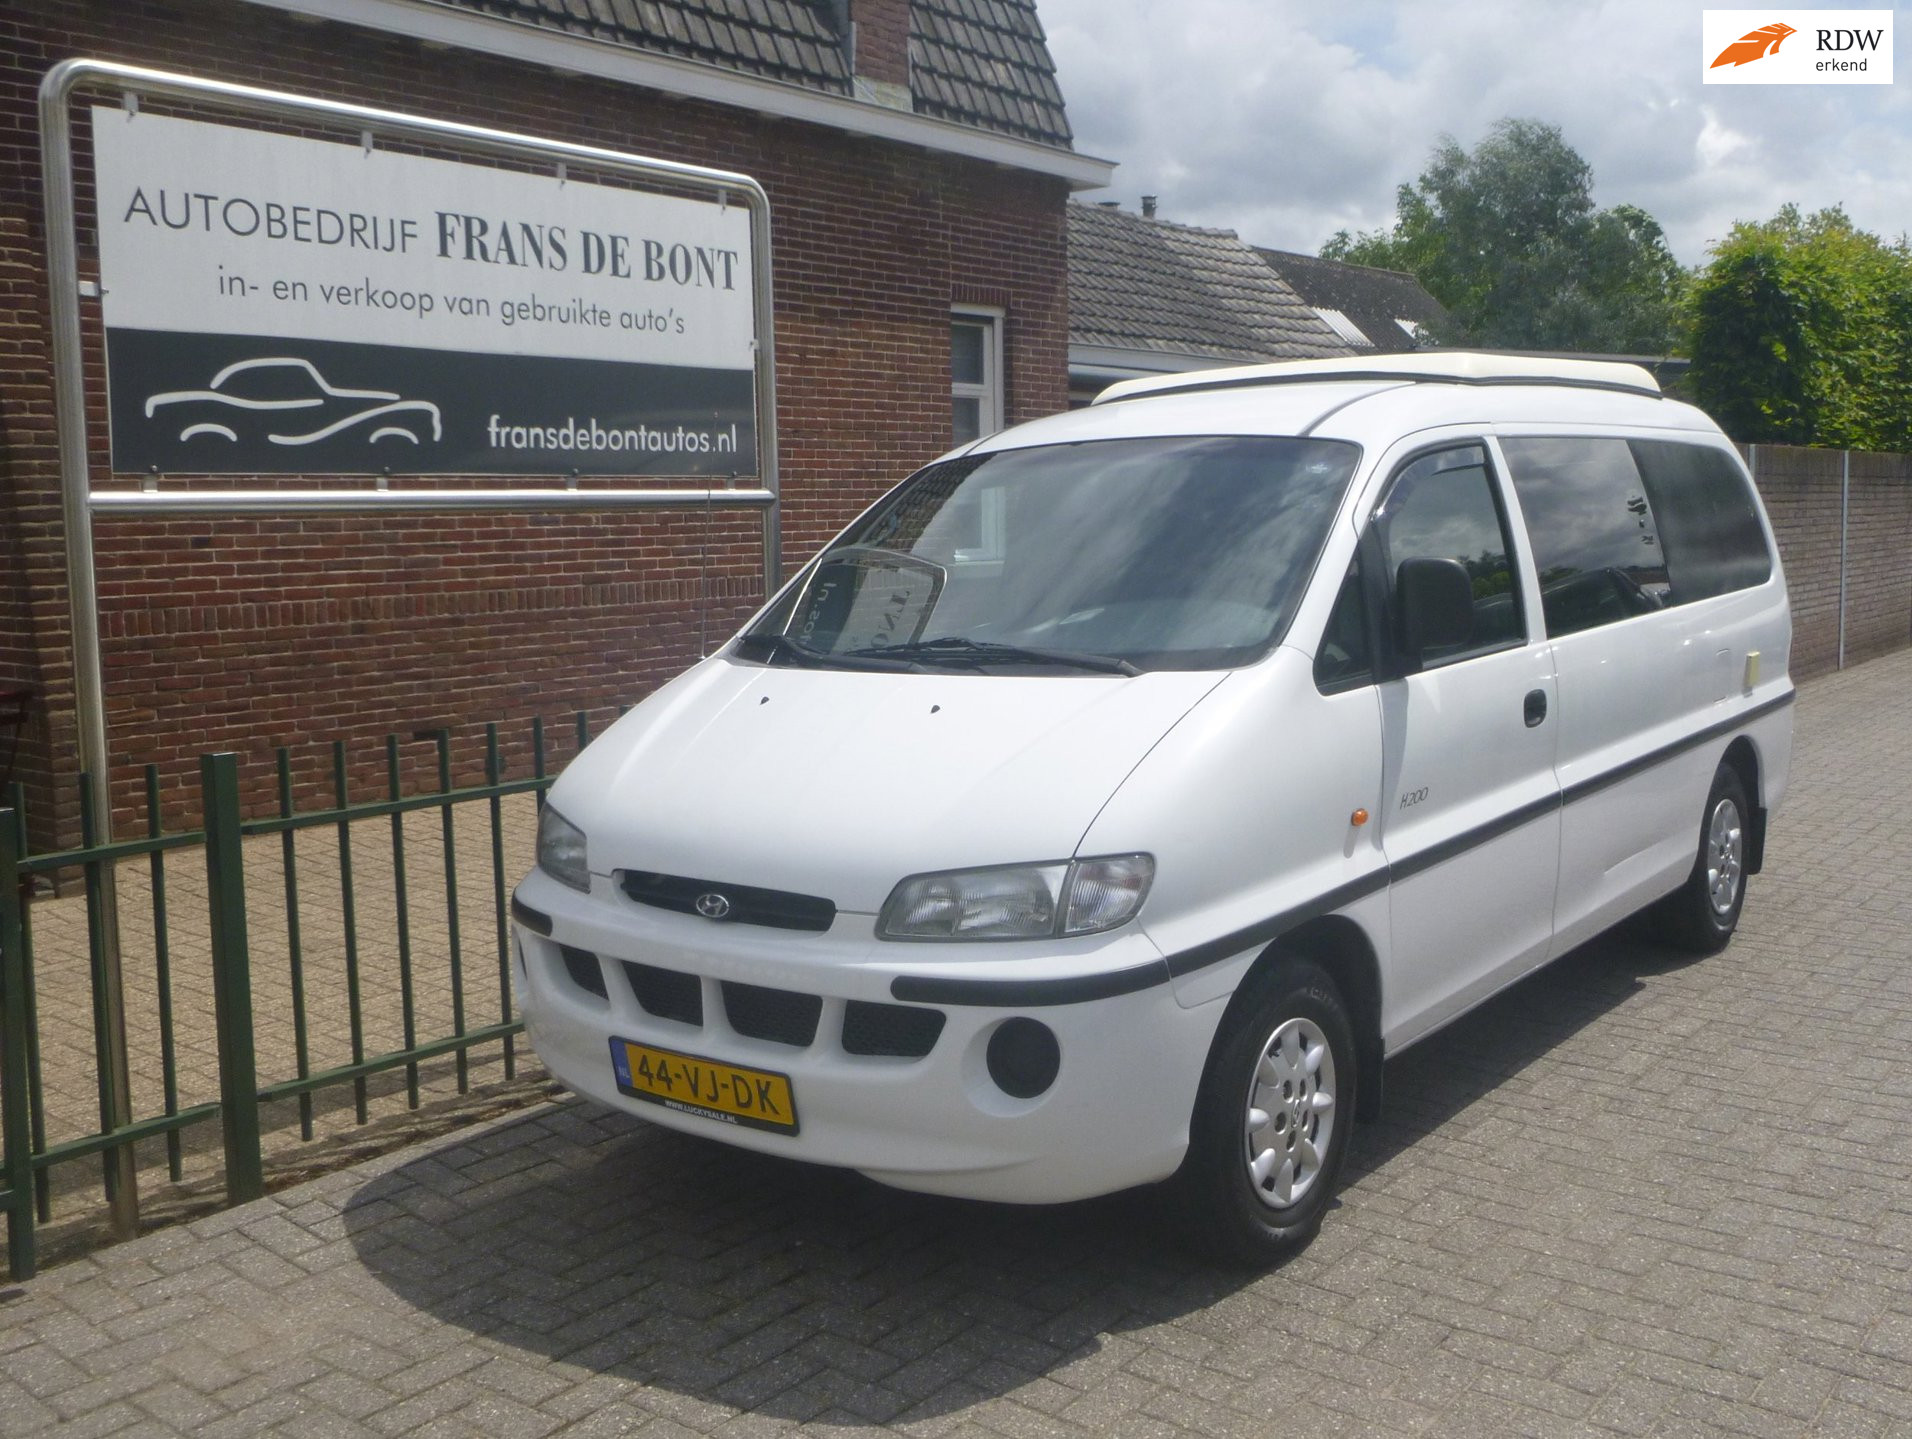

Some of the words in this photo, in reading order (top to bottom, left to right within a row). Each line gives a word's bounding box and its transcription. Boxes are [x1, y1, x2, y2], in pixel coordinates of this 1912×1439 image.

[124, 186, 418, 253] AUTOBEDRIJF
[434, 211, 568, 272] FRANS
[580, 230, 631, 279] DE
[641, 239, 738, 291] BONT
[218, 265, 259, 296] in-
[272, 280, 308, 302] en
[319, 277, 433, 319] verkoop
[444, 295, 490, 317] van
[501, 294, 611, 326] gebruikte
[620, 308, 685, 334] auto's
[487, 414, 737, 453] fransdebontautos.nl
[1400, 786, 1429, 811] H200
[617, 1065, 631, 1079] NL
[638, 1054, 780, 1116] 44-VJ-DK
